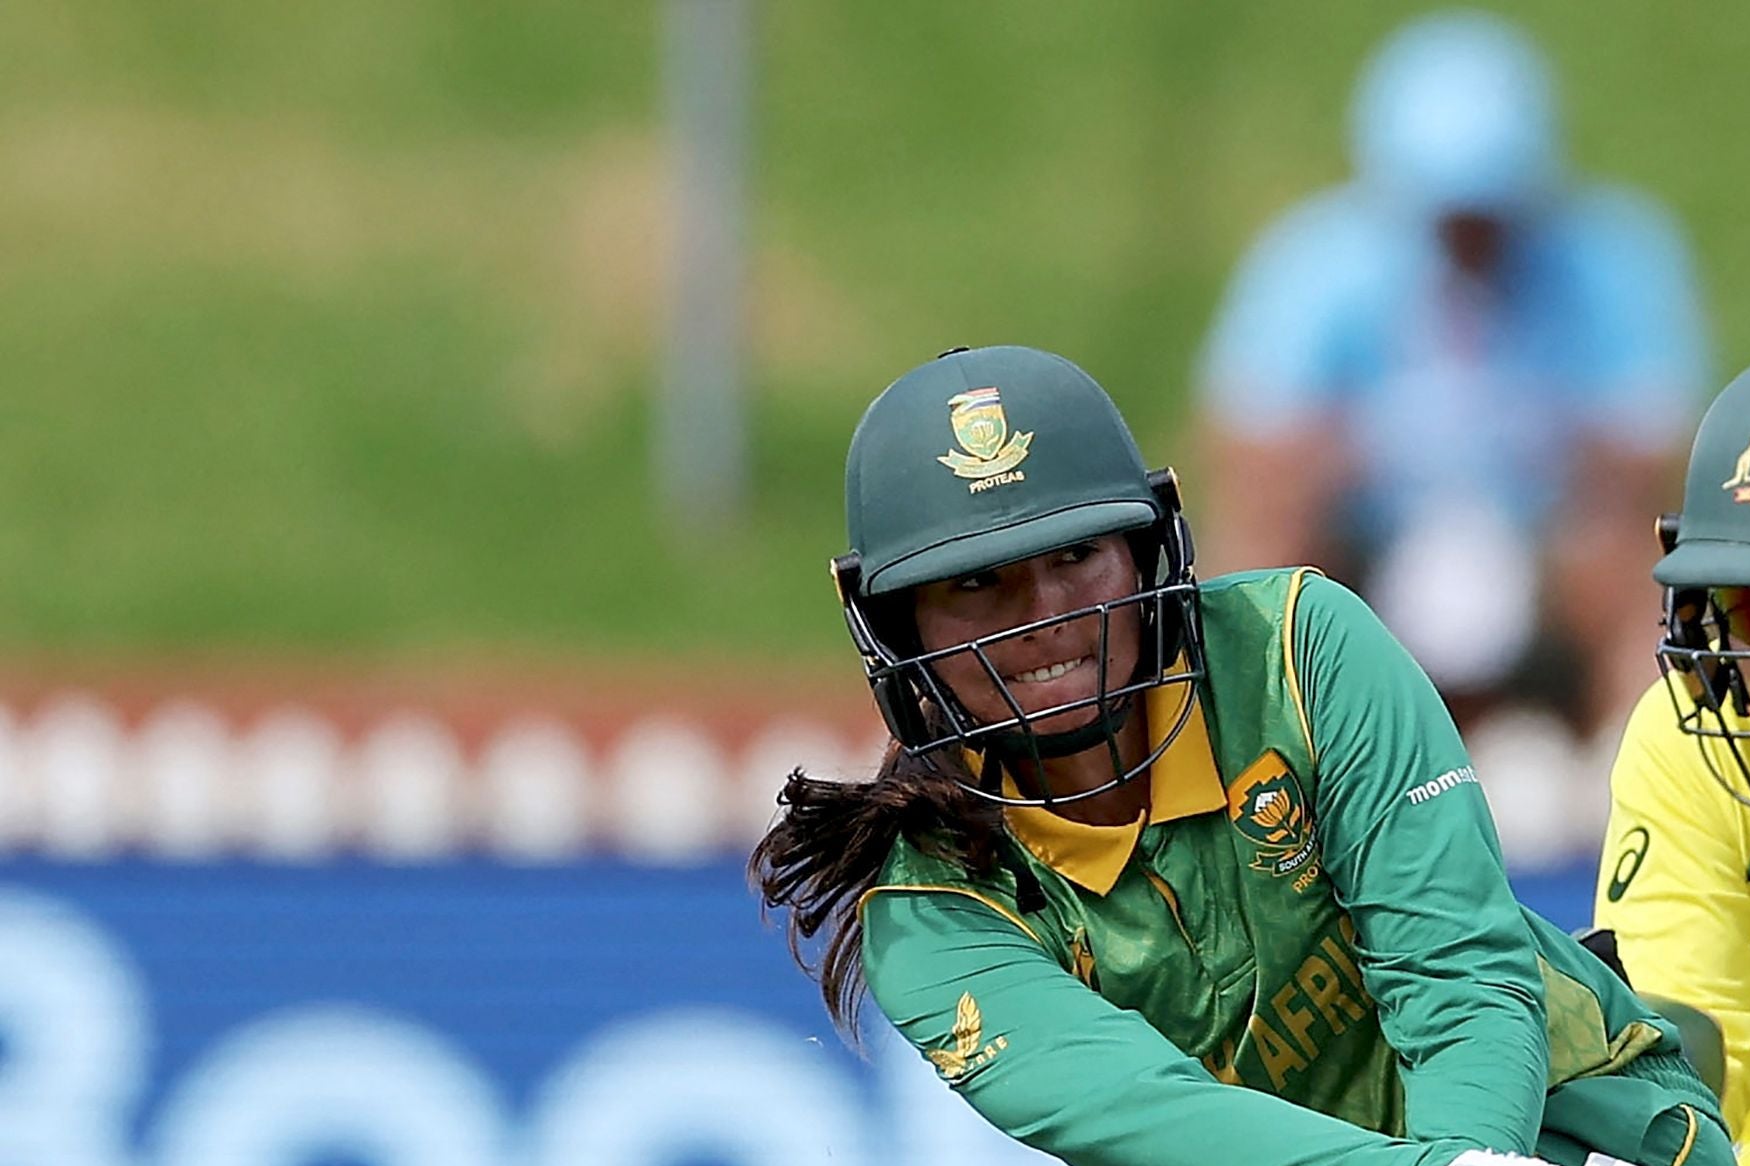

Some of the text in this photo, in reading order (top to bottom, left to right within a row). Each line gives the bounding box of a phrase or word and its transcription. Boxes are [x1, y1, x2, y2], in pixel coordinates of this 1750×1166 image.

[968, 471, 1025, 494] PROTEAS
[1278, 846, 1309, 872] SOUTH
[1292, 860, 1321, 894] PRO
